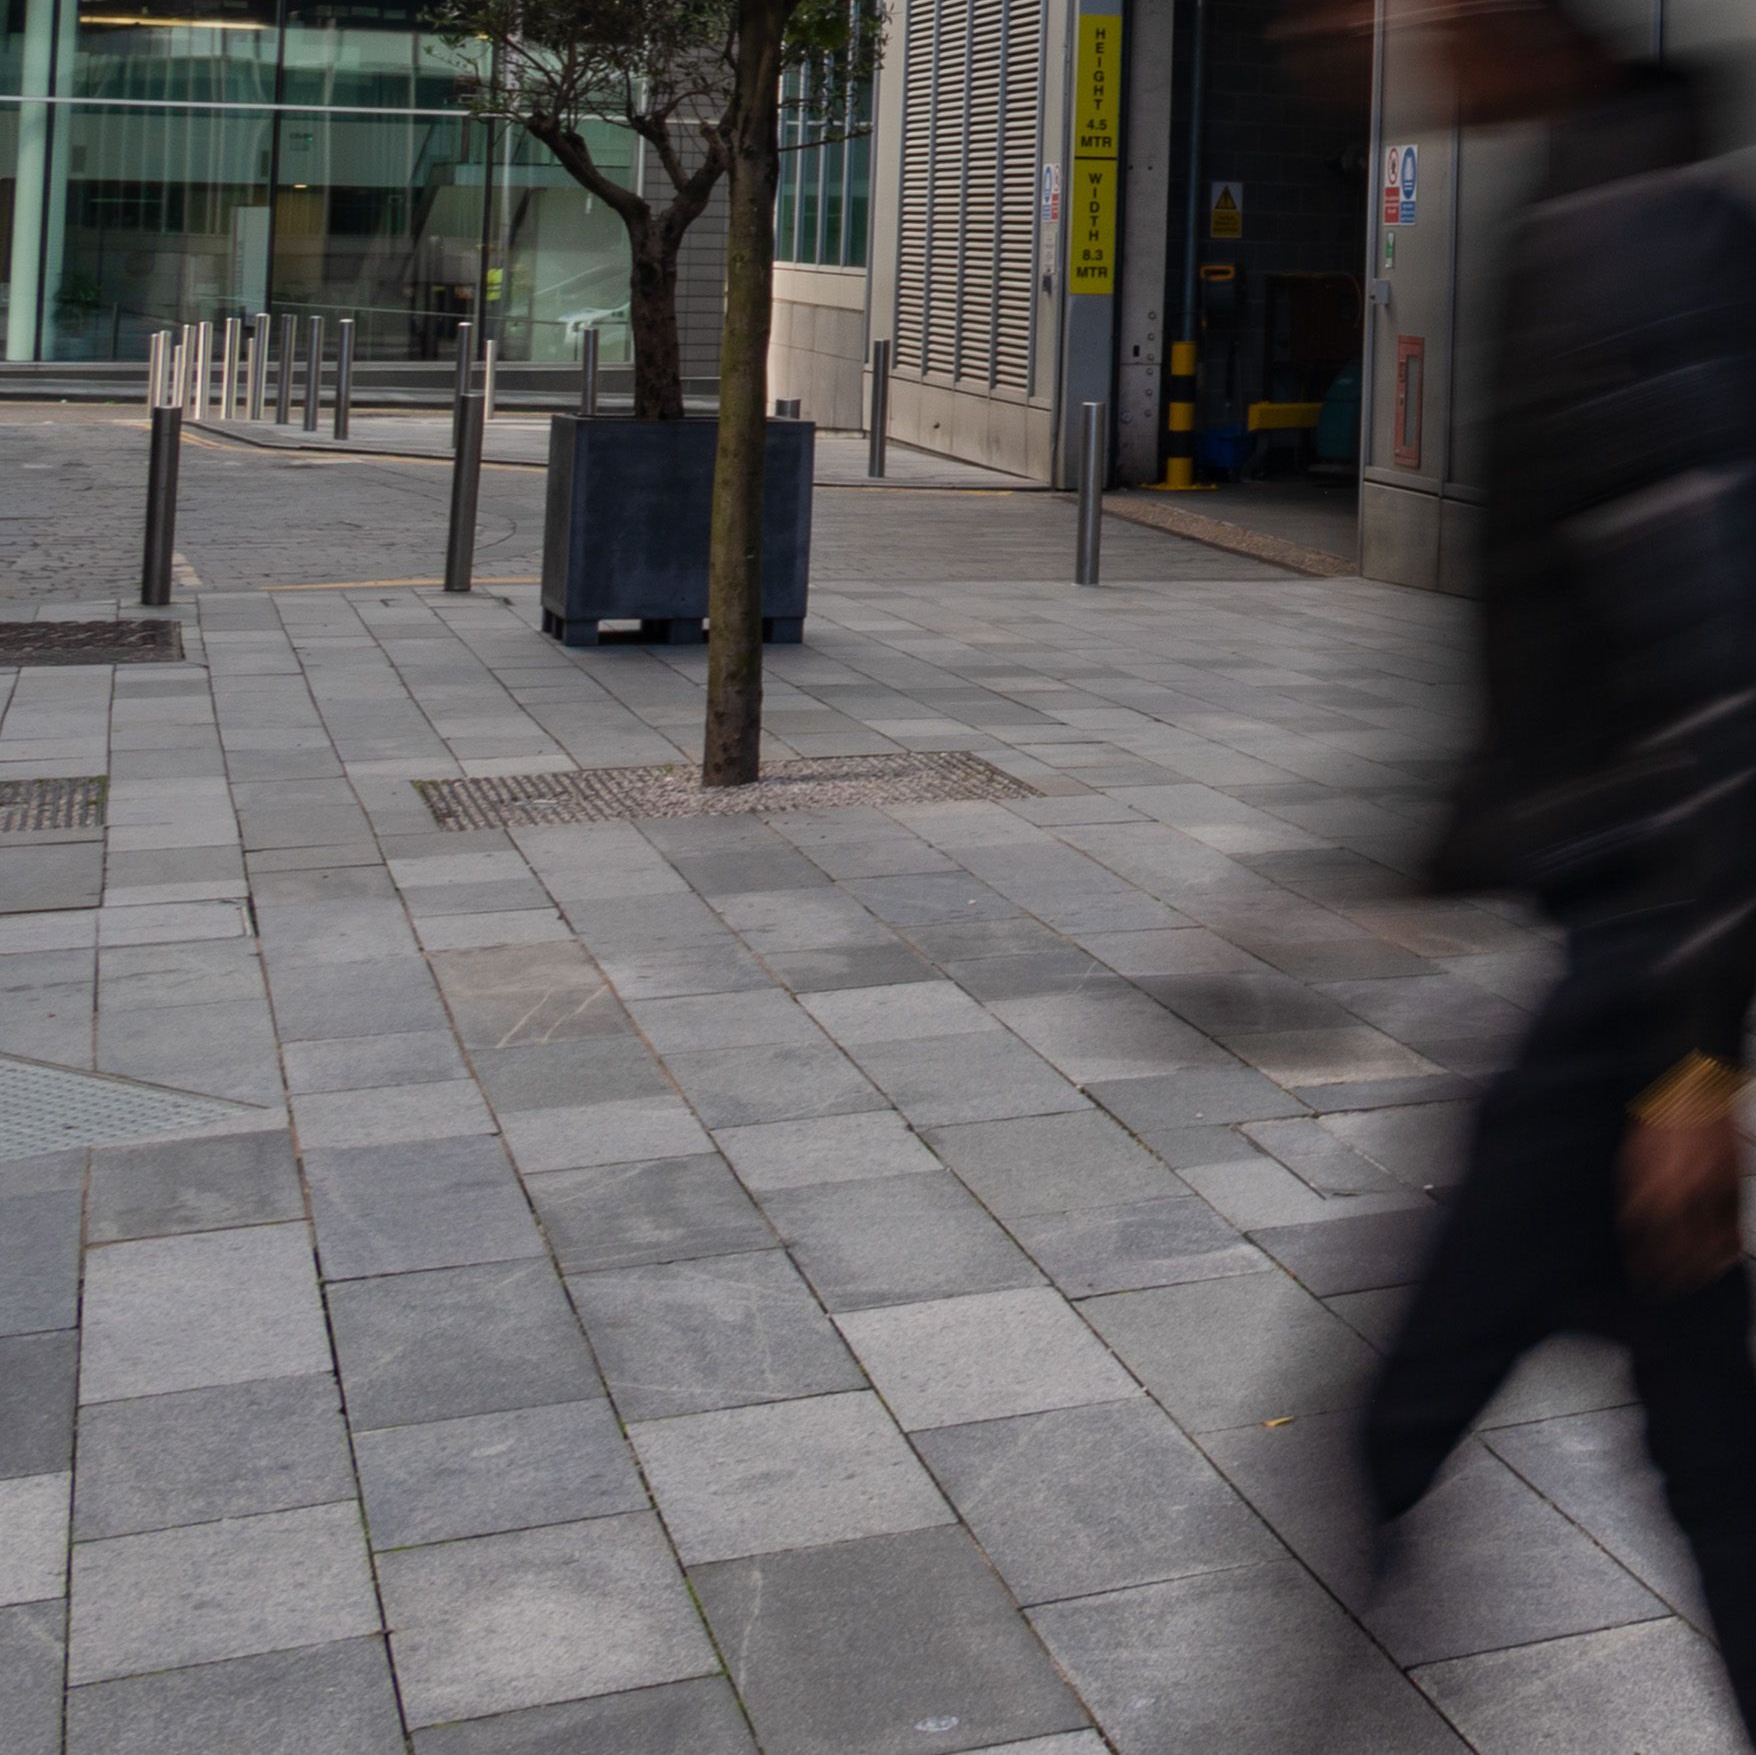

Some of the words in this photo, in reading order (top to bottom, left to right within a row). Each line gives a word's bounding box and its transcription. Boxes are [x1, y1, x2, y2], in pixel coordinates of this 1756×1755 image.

[1093, 28, 1106, 110] HEIGHT
[1086, 119, 1108, 131] 4.5
[1080, 135, 1112, 148] MTR
[1088, 173, 1103, 241] WIDTH
[1082, 249, 1103, 261] 8.3
[1076, 266, 1108, 278] MTR
